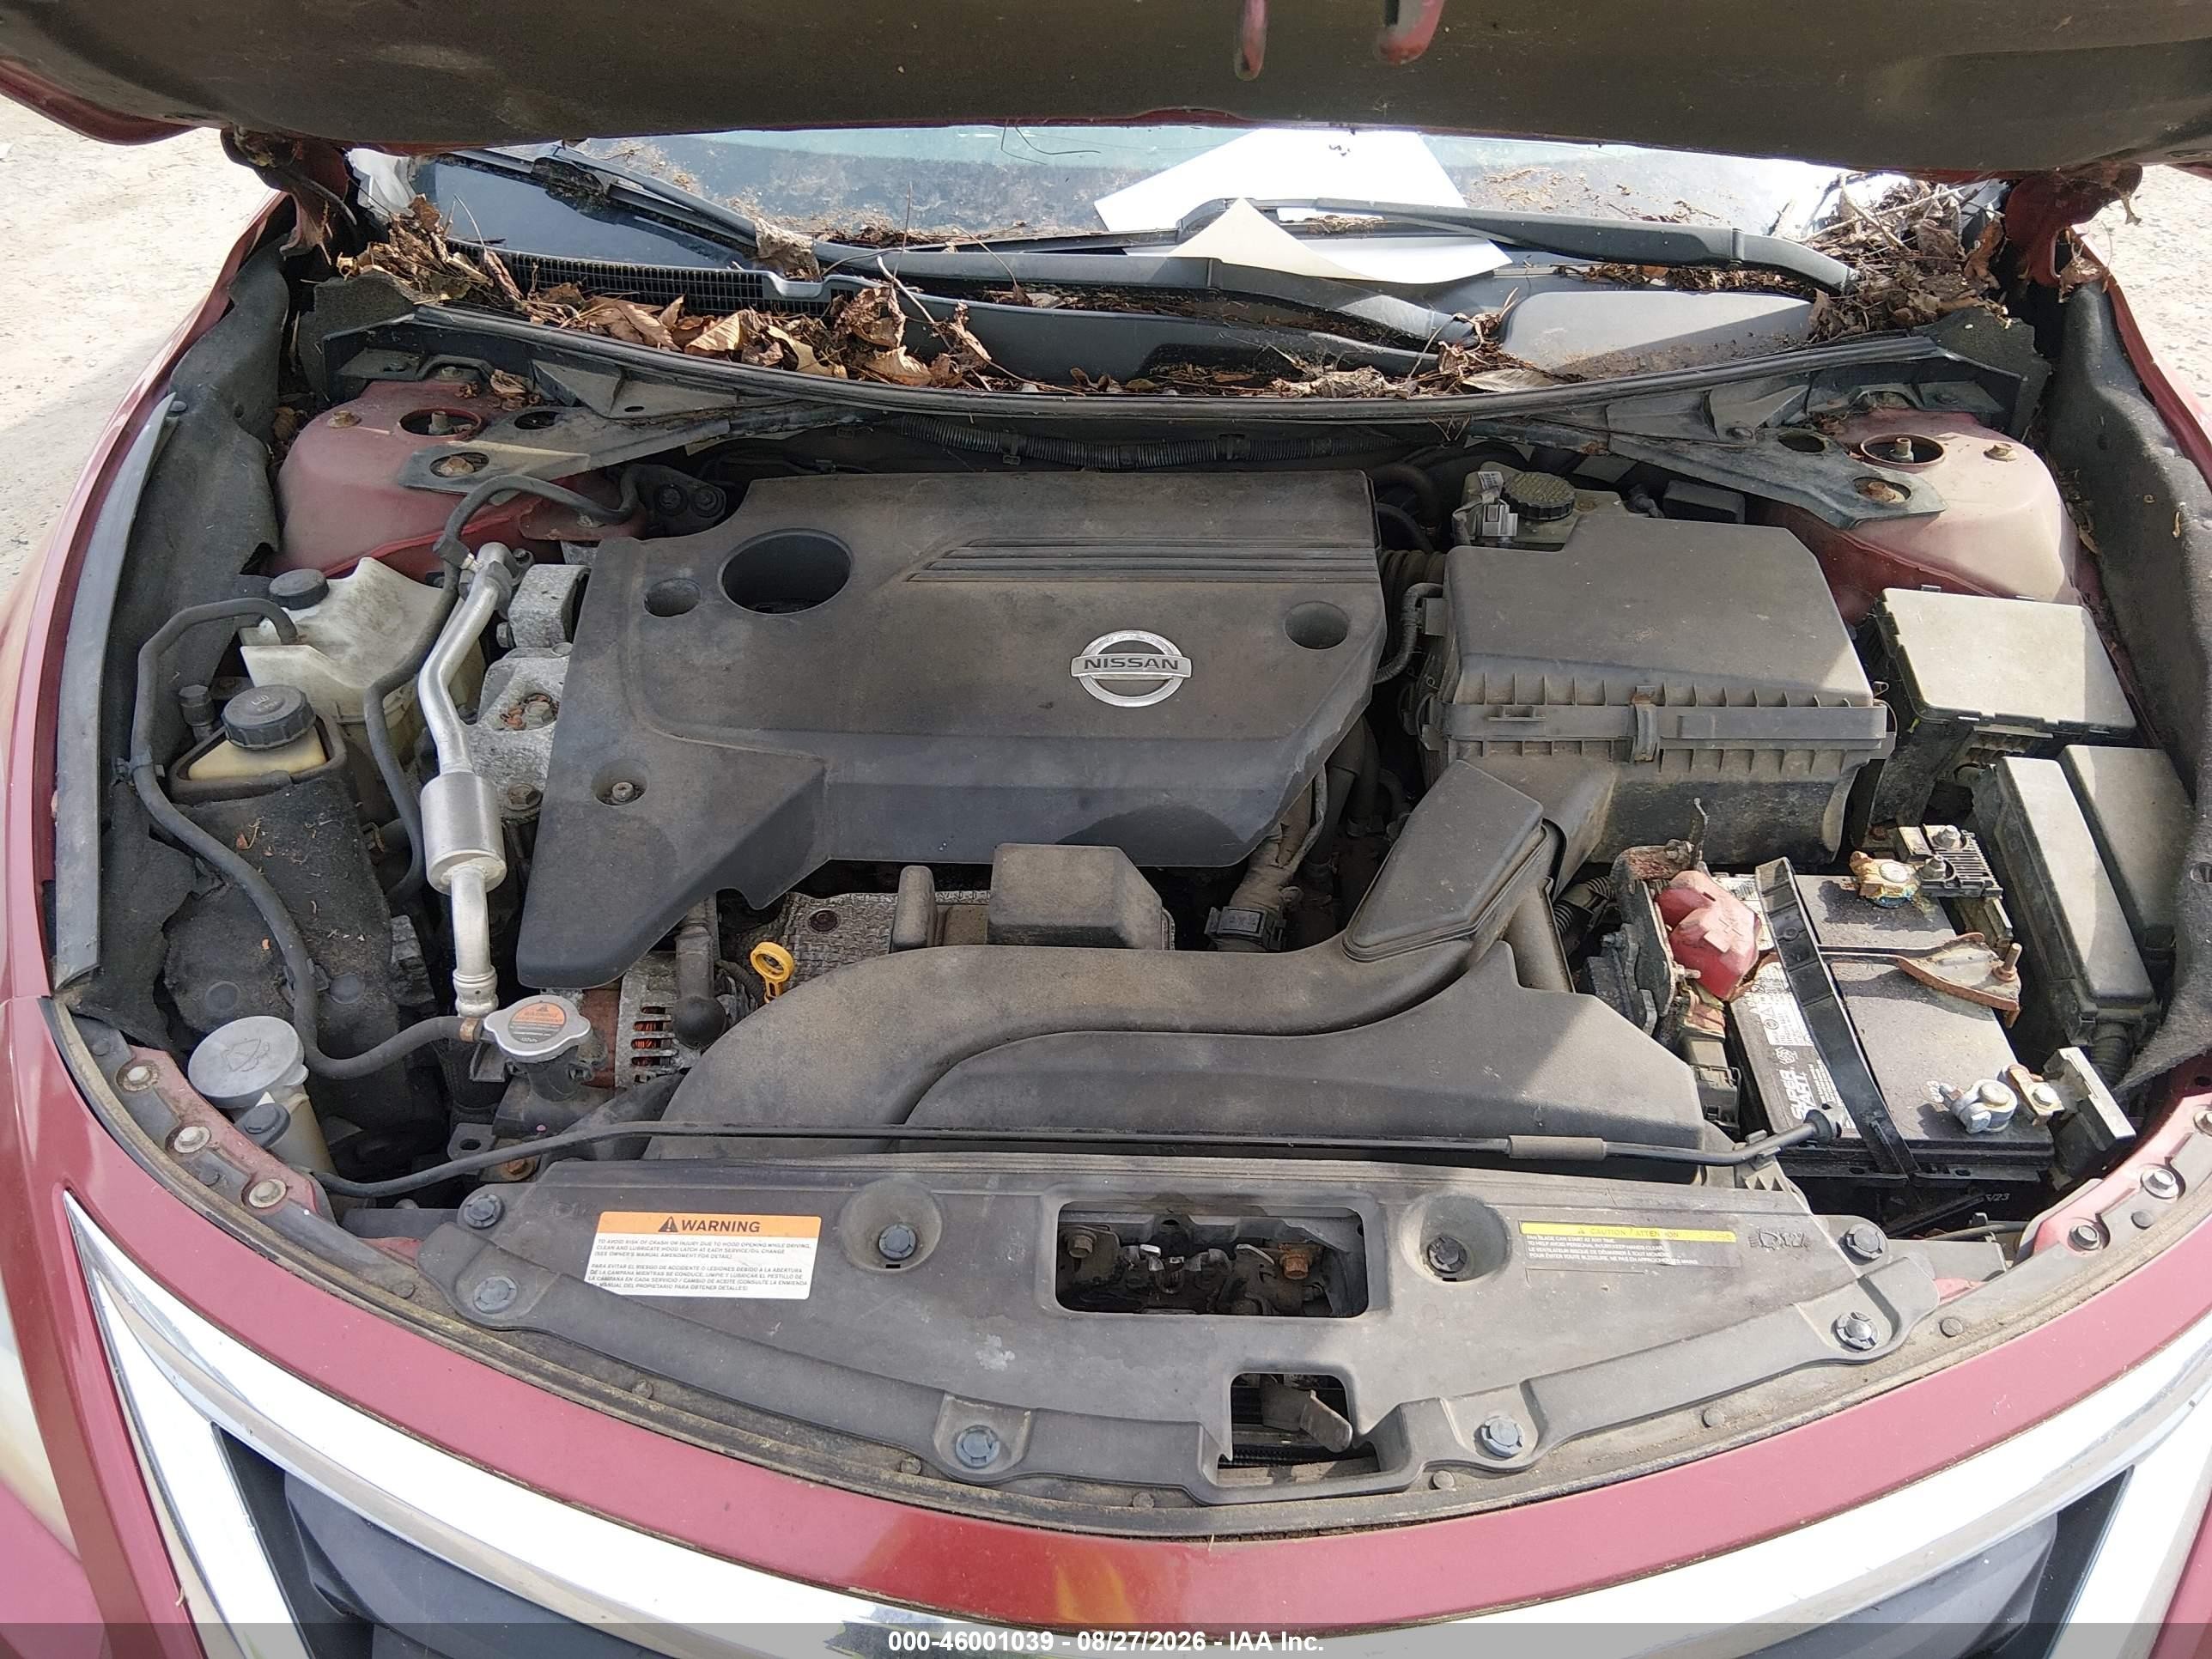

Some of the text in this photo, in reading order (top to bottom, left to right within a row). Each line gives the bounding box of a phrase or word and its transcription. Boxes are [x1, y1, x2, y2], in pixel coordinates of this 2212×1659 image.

[1085, 658, 1178, 670] NISSAN
[1778, 1070, 1804, 1121] SUPER
[682, 1219, 761, 1233] WARNING
